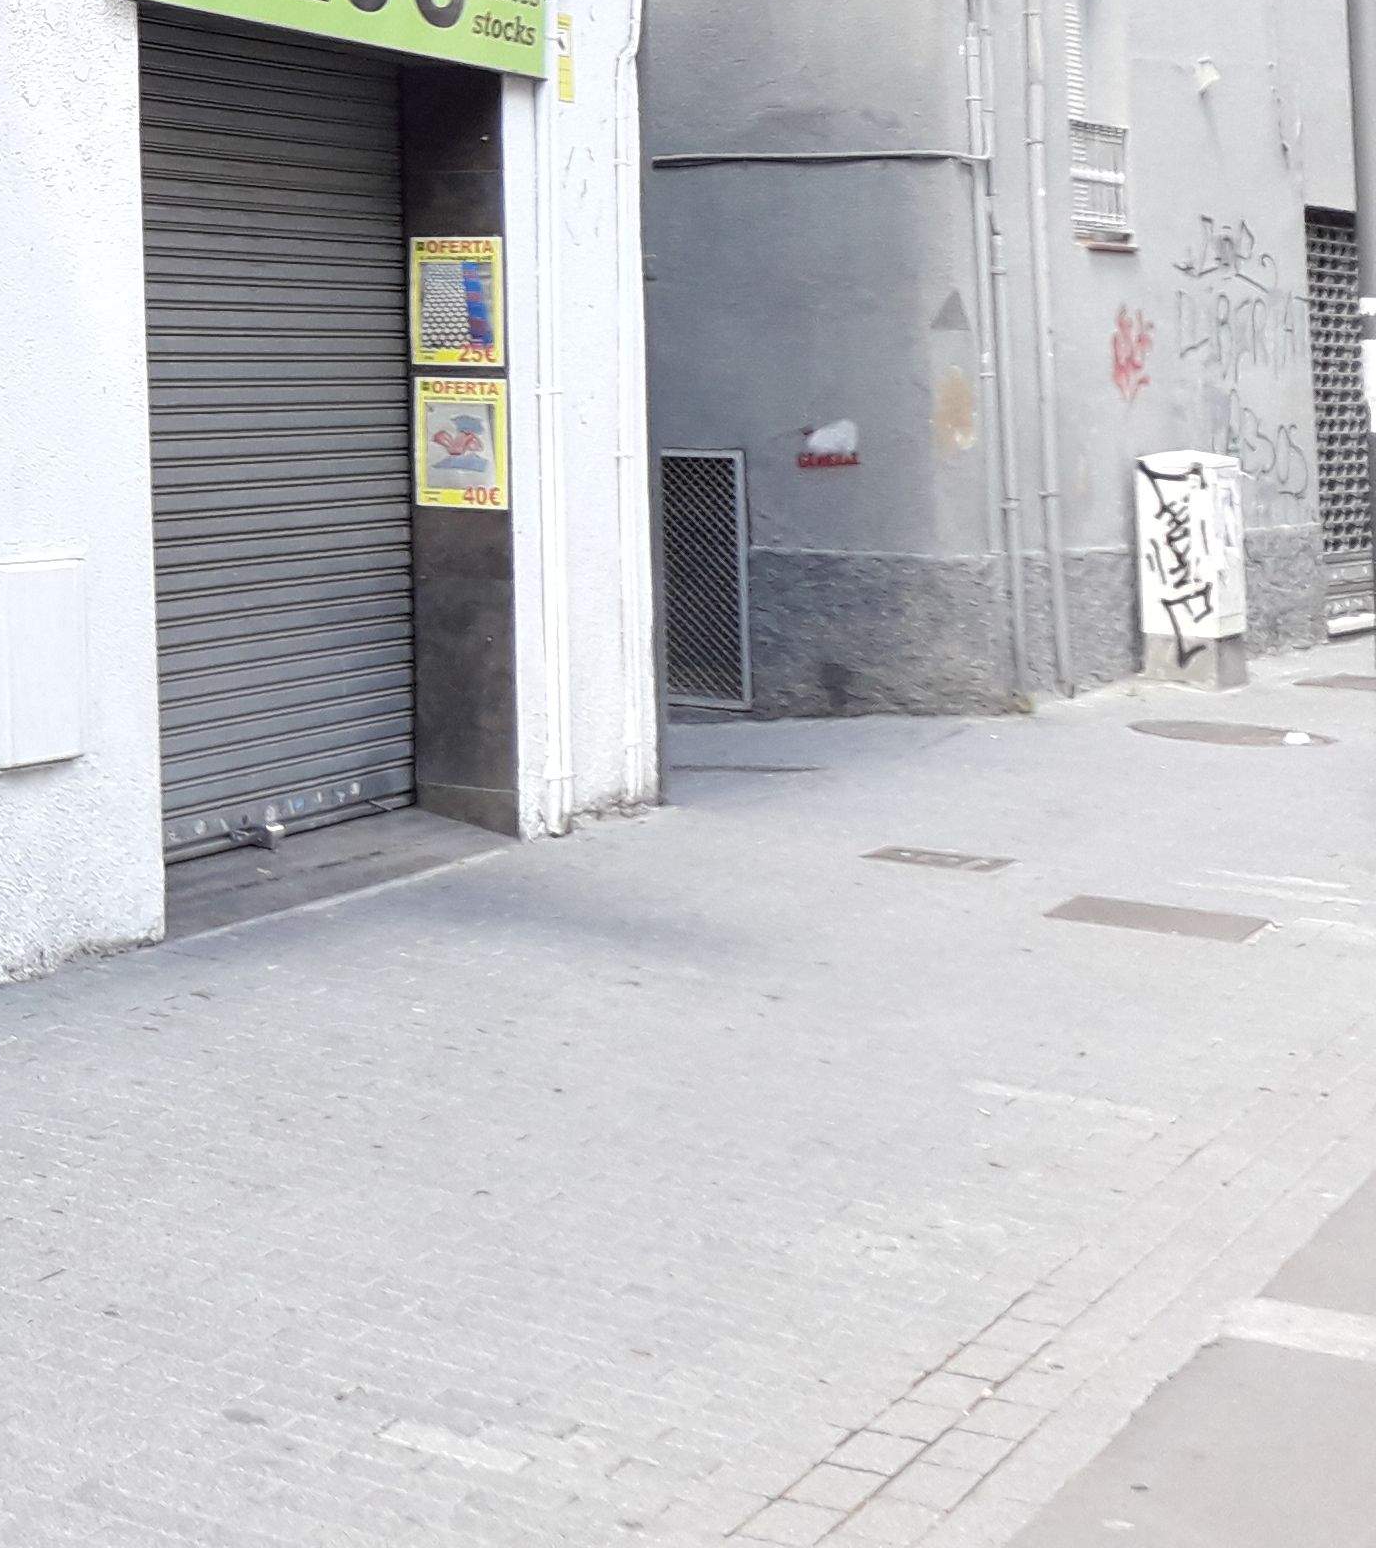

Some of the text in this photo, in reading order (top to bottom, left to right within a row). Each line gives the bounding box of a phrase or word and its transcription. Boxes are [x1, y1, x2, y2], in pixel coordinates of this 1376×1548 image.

[472, 12, 537, 47] stocks
[426, 240, 494, 254] OFERTA
[458, 343, 497, 363] 25€
[432, 380, 500, 396] OFERTA
[463, 485, 502, 506] 40€
